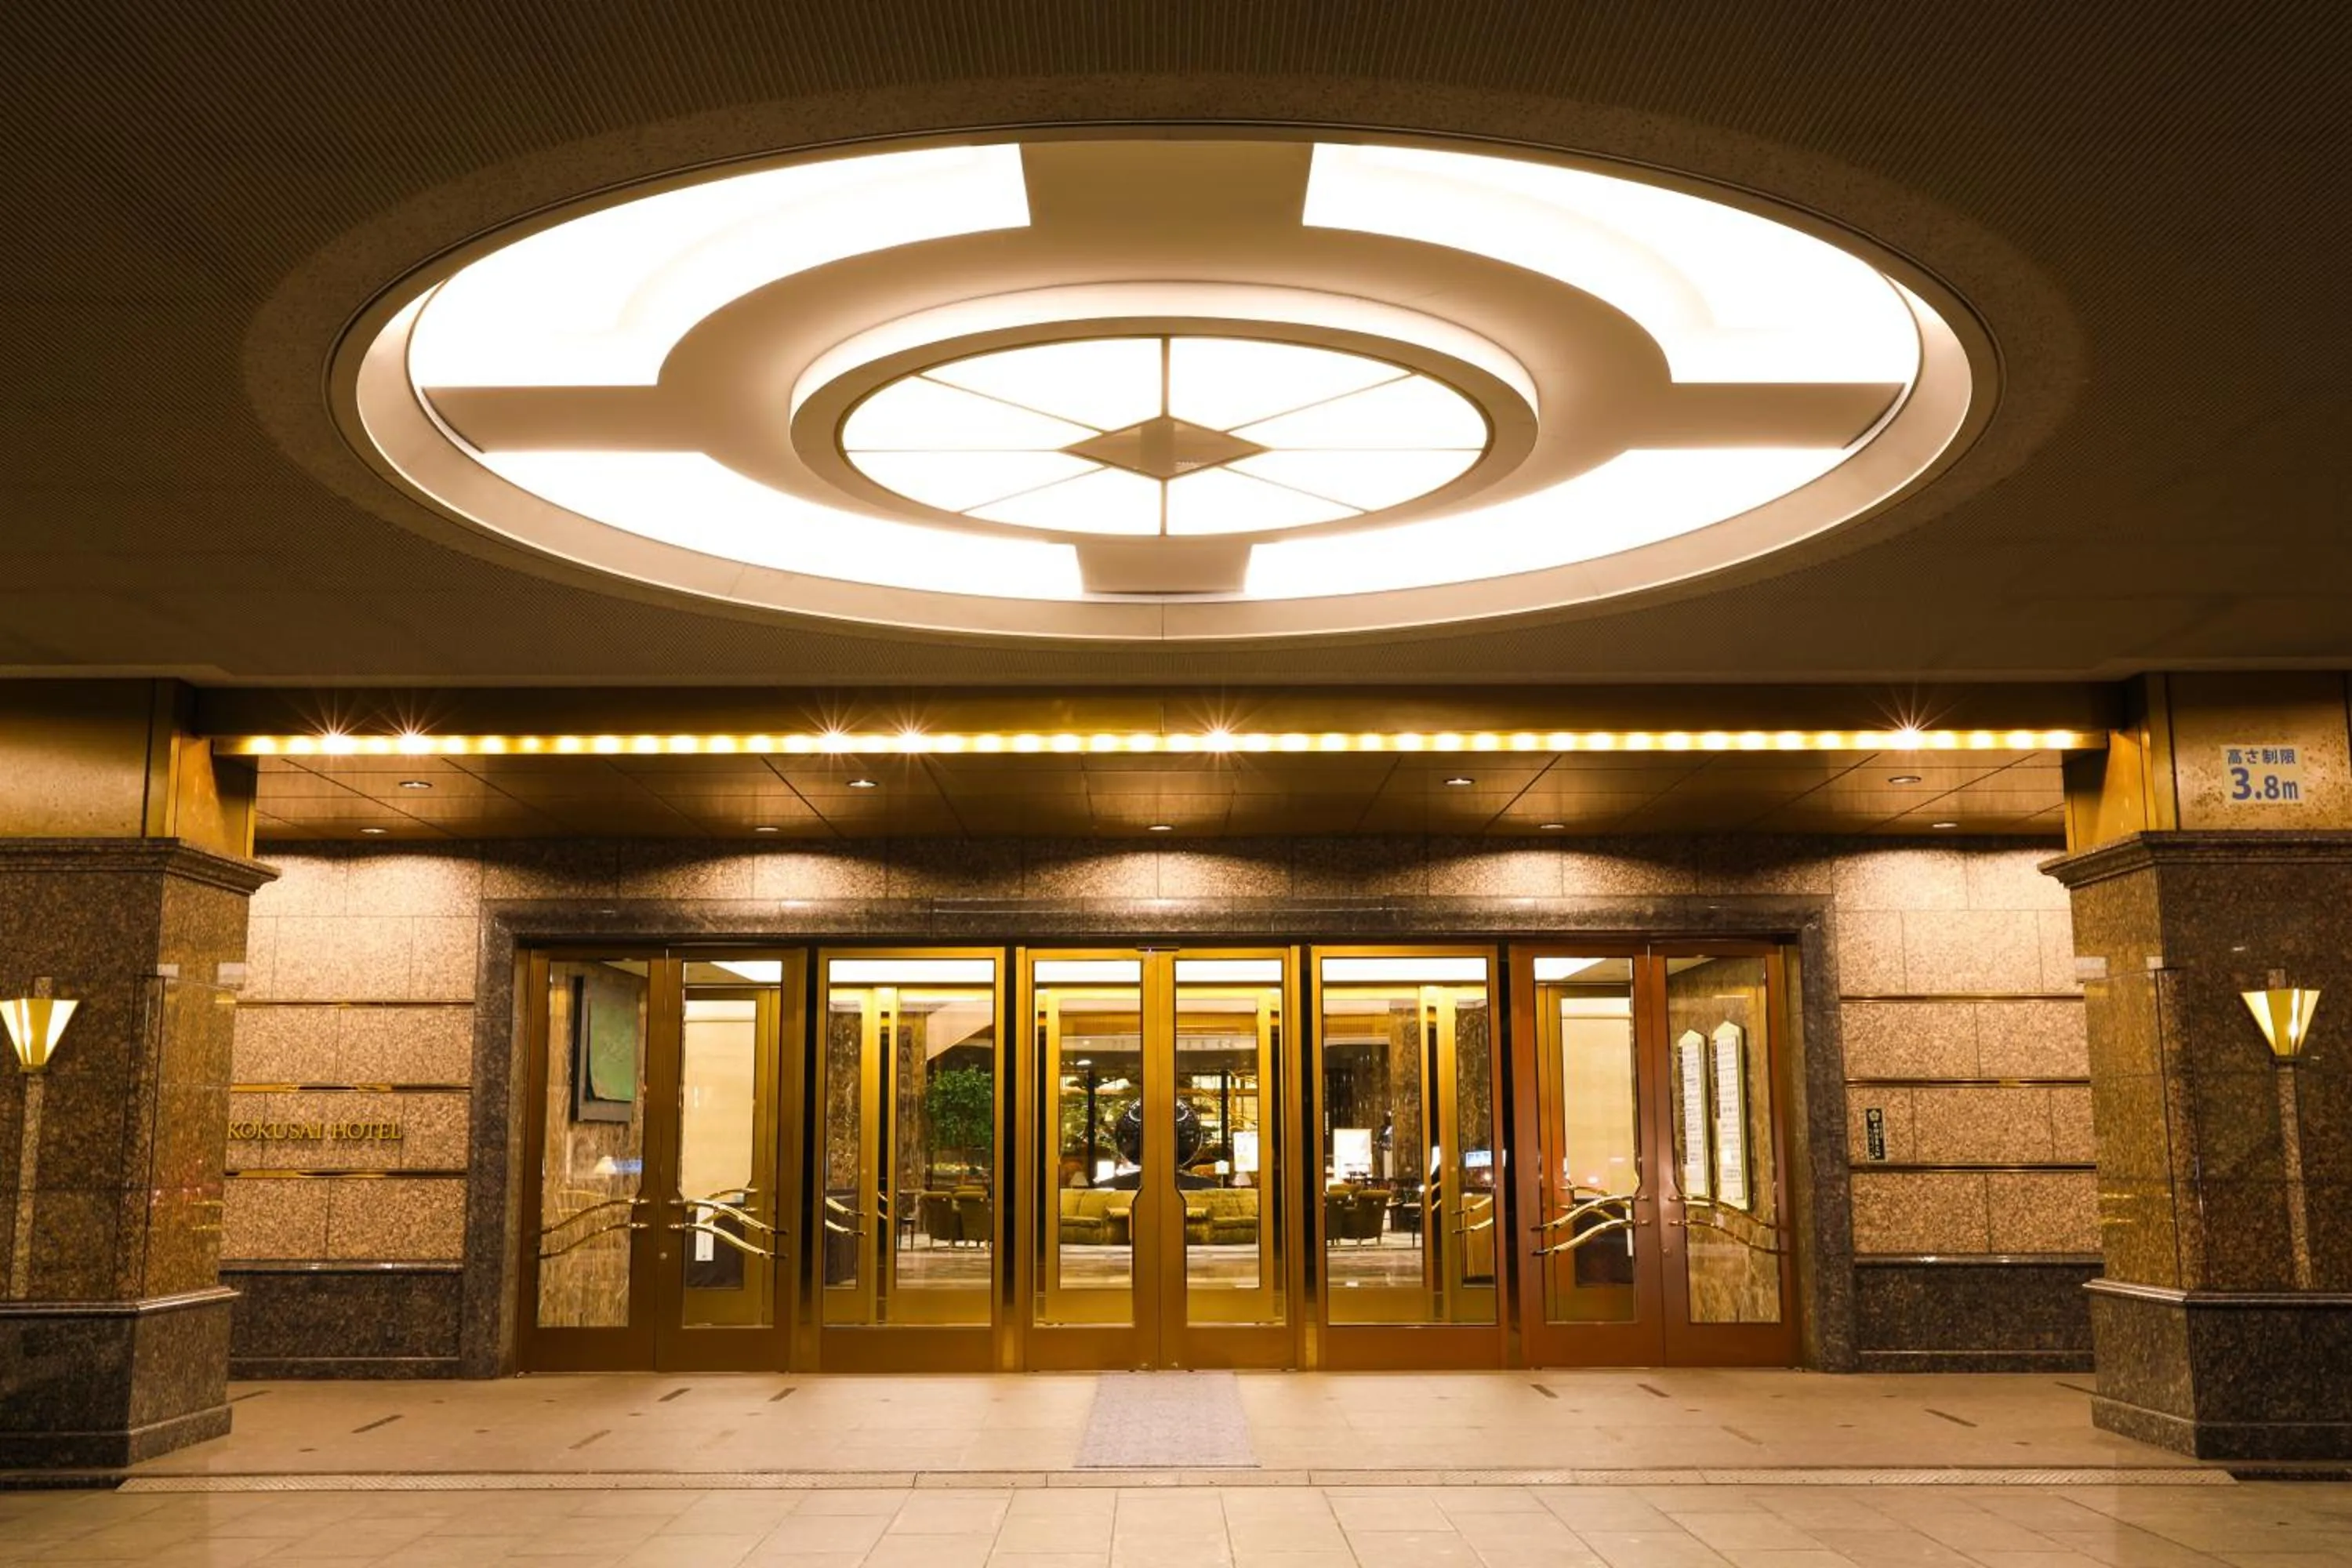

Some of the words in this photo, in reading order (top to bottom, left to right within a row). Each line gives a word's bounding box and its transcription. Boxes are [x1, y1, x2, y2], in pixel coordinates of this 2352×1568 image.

[2227, 748, 2296, 764] 高さ制限
[2230, 767, 2299, 800] 3.8m
[228, 1121, 322, 1139] KOKUSAI
[332, 1121, 402, 1139] HOTEL
